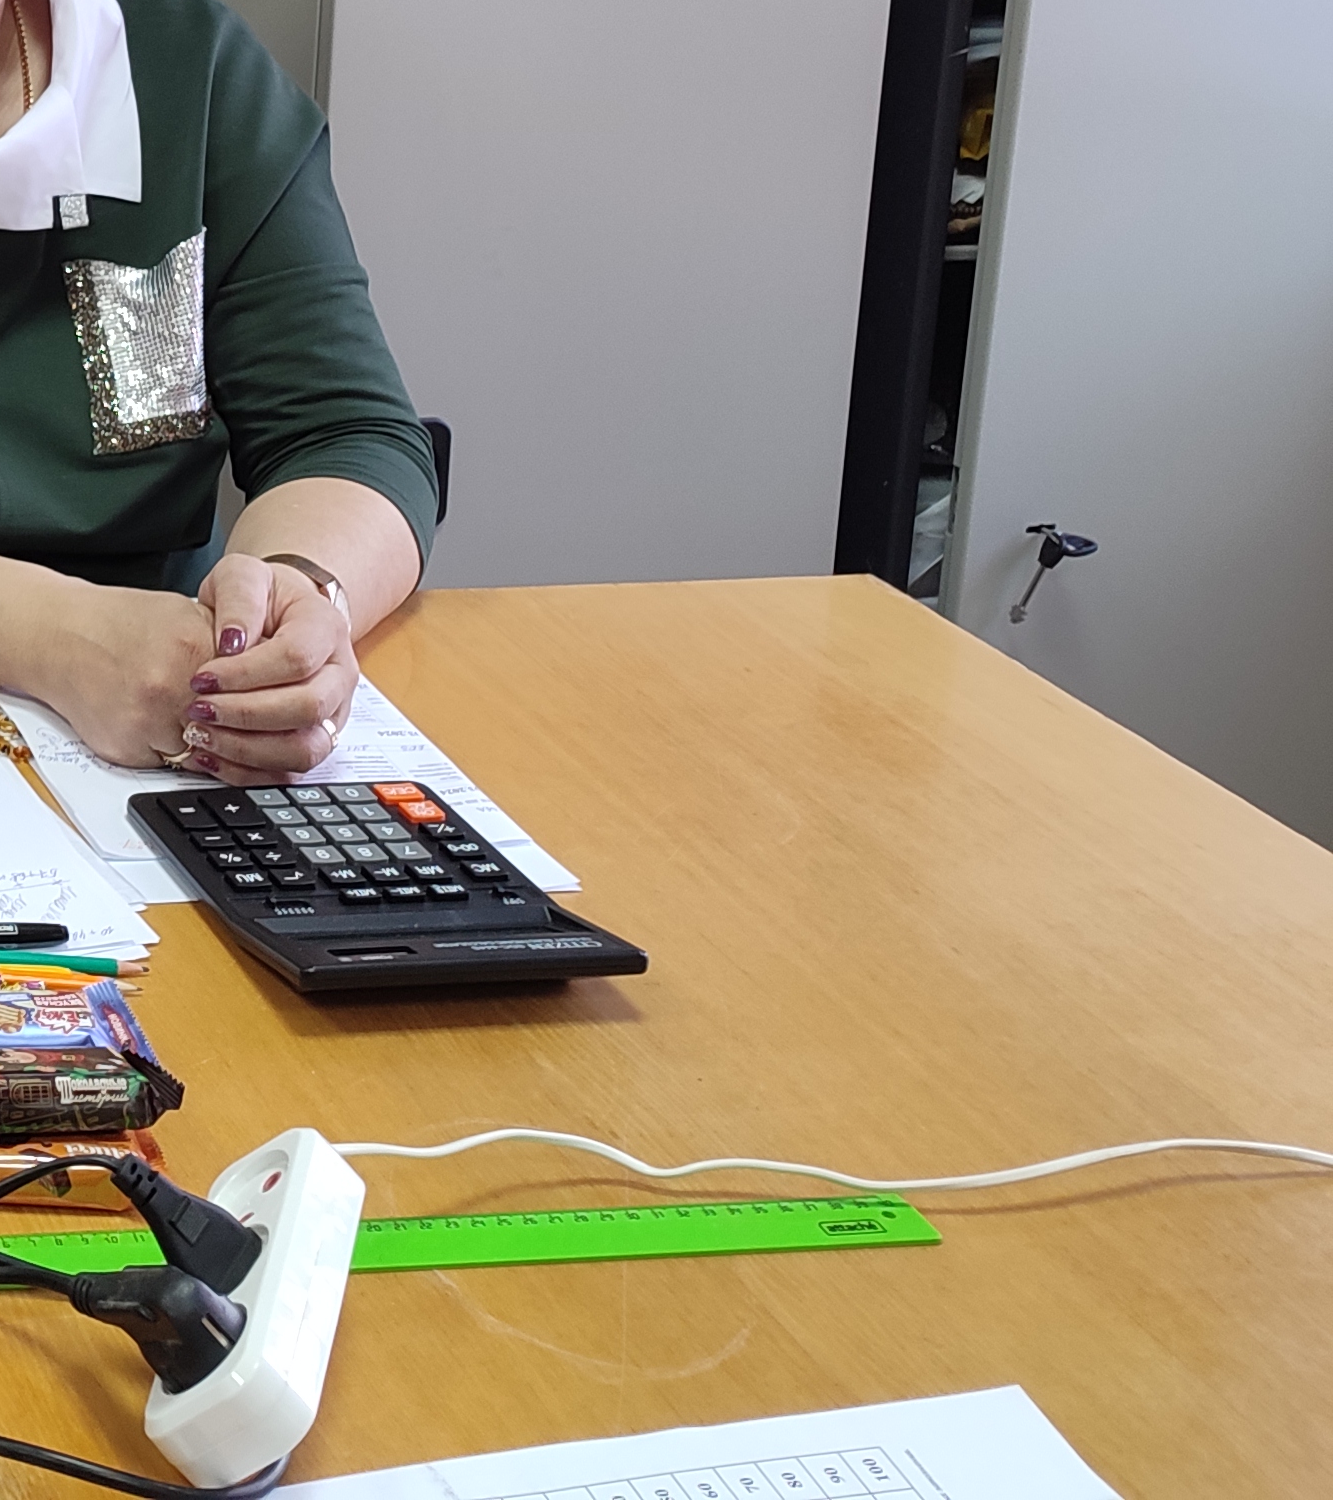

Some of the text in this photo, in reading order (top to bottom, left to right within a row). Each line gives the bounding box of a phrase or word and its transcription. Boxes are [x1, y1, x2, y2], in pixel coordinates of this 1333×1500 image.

[297, 790, 320, 800] 00
[345, 788, 357, 798] 0
[277, 810, 292, 820] 3
[319, 808, 333, 818] 2
[365, 807, 374, 817] 1
[296, 829, 309, 839] 6
[339, 827, 351, 837] 5
[382, 826, 393, 836] 4
[316, 848, 327, 859] 9
[358, 847, 370, 857] 8
[403, 846, 413, 855] 7
[415, 864, 445, 876] MR
[471, 862, 500, 875] MC
[235, 872, 263, 883] MU
[104, 1235, 119, 1245] 10
[366, 1222, 382, 1232] 20
[393, 1221, 407, 1231] 21
[419, 1220, 433, 1230] 22
[445, 1219, 459, 1229] 23
[470, 1218, 486, 1228] 24
[496, 1217, 512, 1227] 25
[522, 1216, 538, 1225] 26
[547, 1215, 563, 1224] 27
[573, 1213, 589, 1222] 28
[599, 1212, 615, 1222] 29
[625, 1211, 641, 1221] 30
[826, 1222, 878, 1233] attaché
[861, 1457, 891, 1482] 100
[780, 1471, 804, 1489] 80
[823, 1466, 843, 1485] 90
[739, 1476, 760, 1494] 70
[697, 1482, 718, 1500] 60
